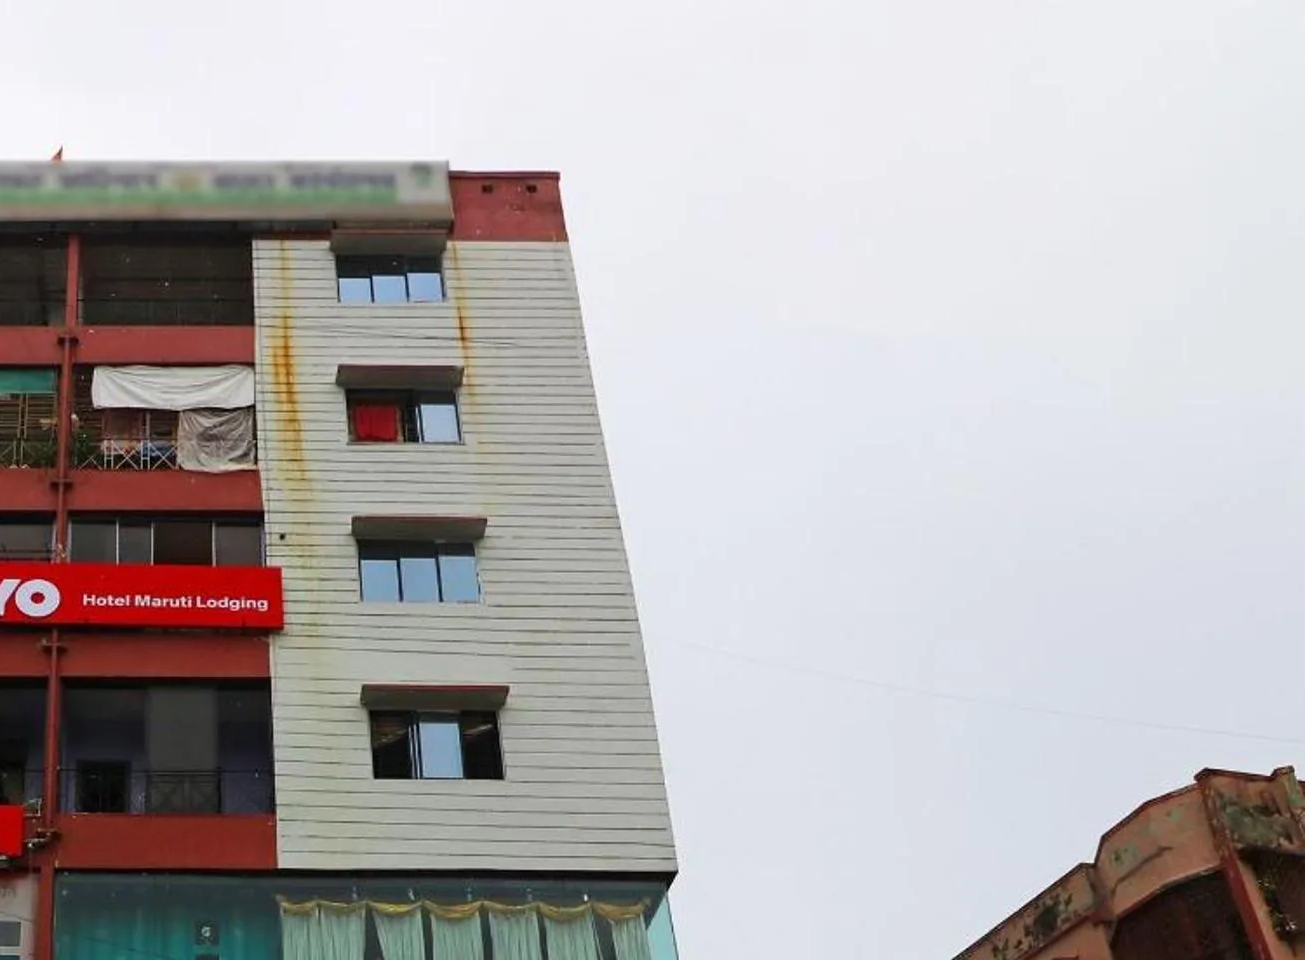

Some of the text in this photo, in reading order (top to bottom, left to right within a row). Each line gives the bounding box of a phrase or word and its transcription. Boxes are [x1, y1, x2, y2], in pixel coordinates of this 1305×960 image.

[82, 594, 130, 607] Hotel
[134, 594, 192, 608] Maruti
[196, 596, 268, 612] Lodging
